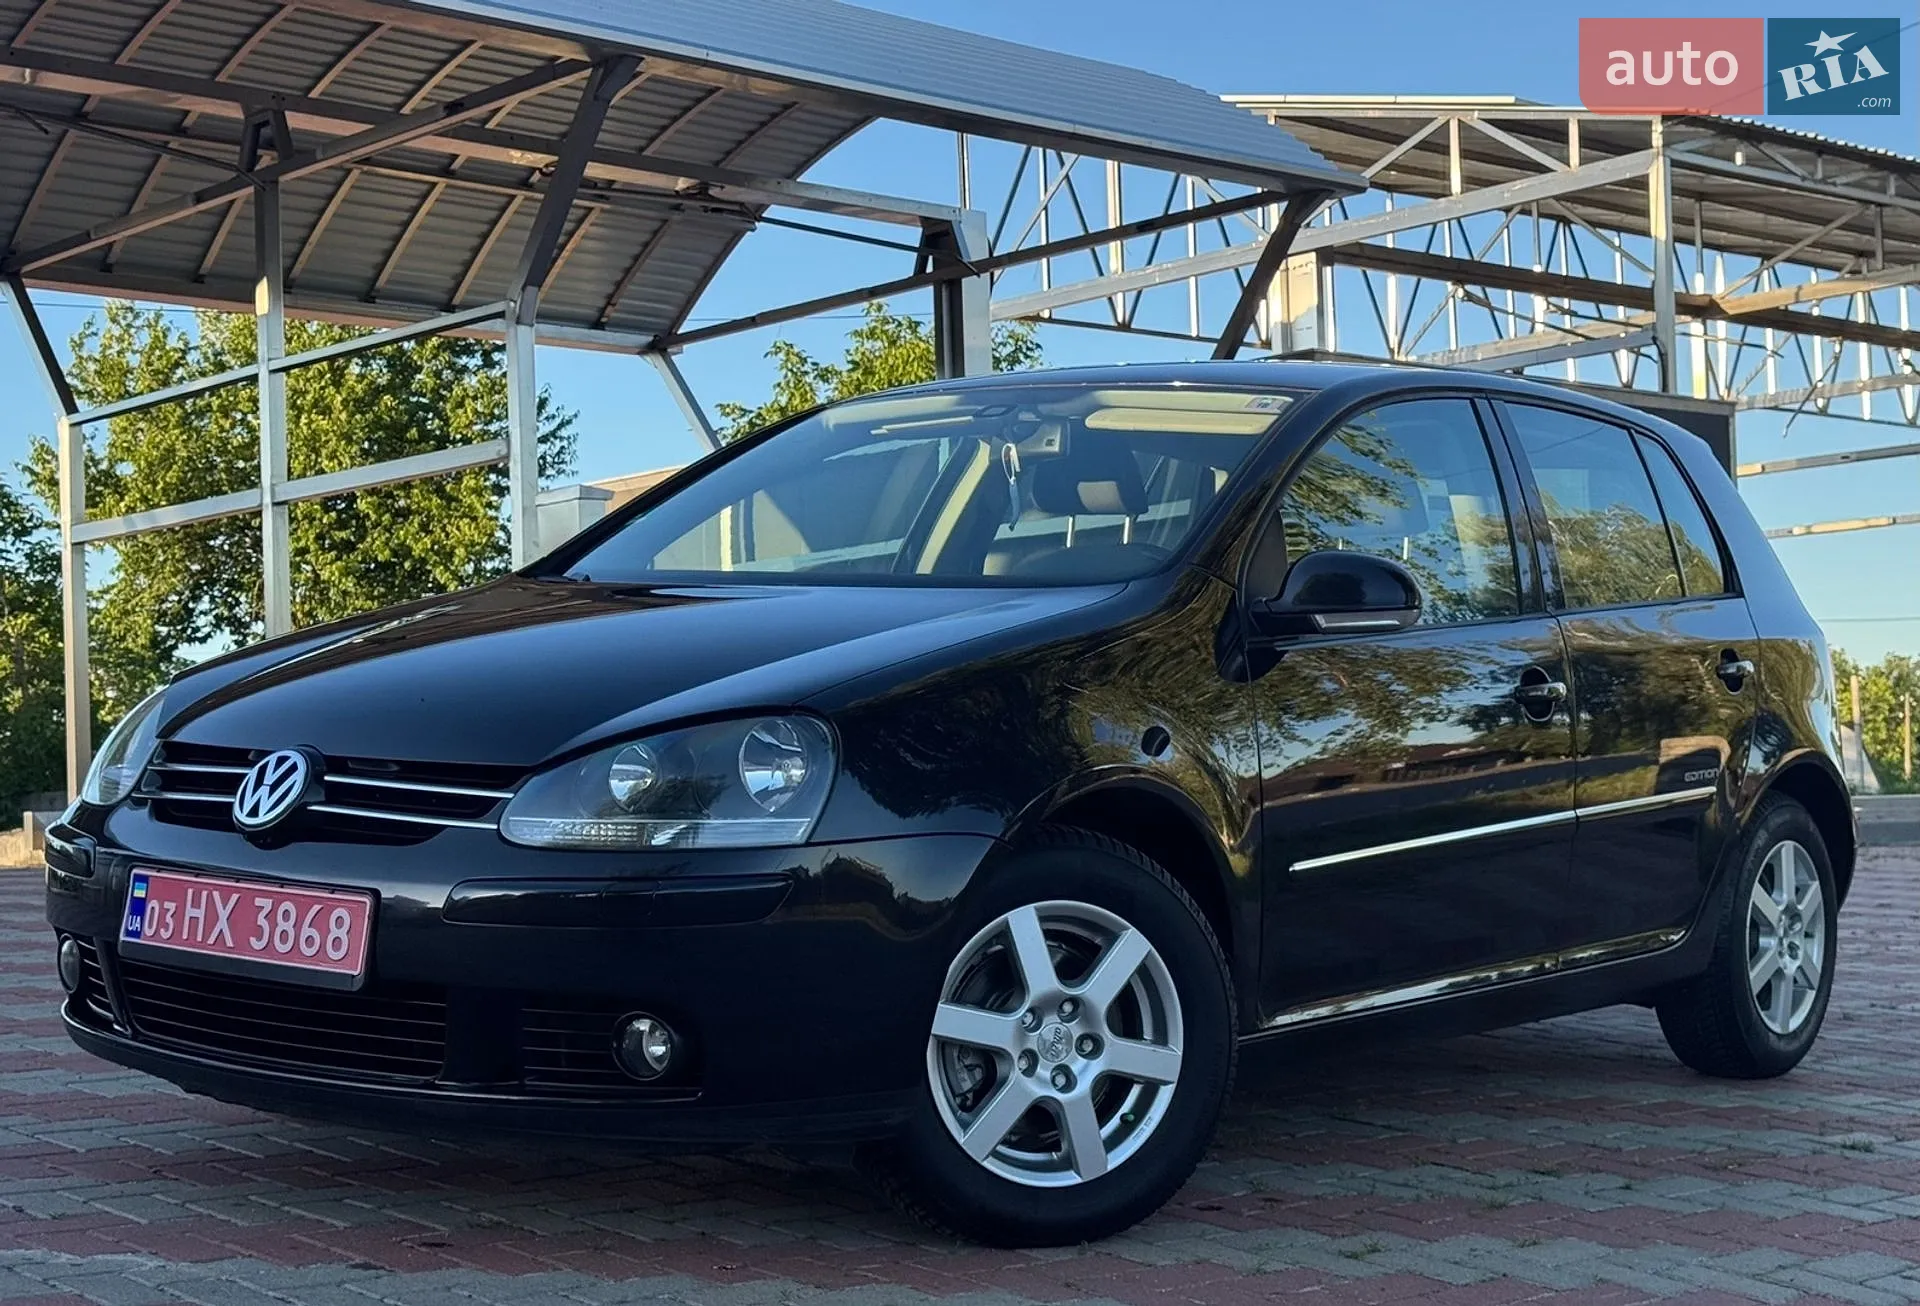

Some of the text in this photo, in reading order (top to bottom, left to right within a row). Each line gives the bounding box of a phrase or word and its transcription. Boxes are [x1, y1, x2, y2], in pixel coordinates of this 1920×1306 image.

[127, 914, 142, 932] UA
[143, 887, 351, 960] 03 HX 3868
